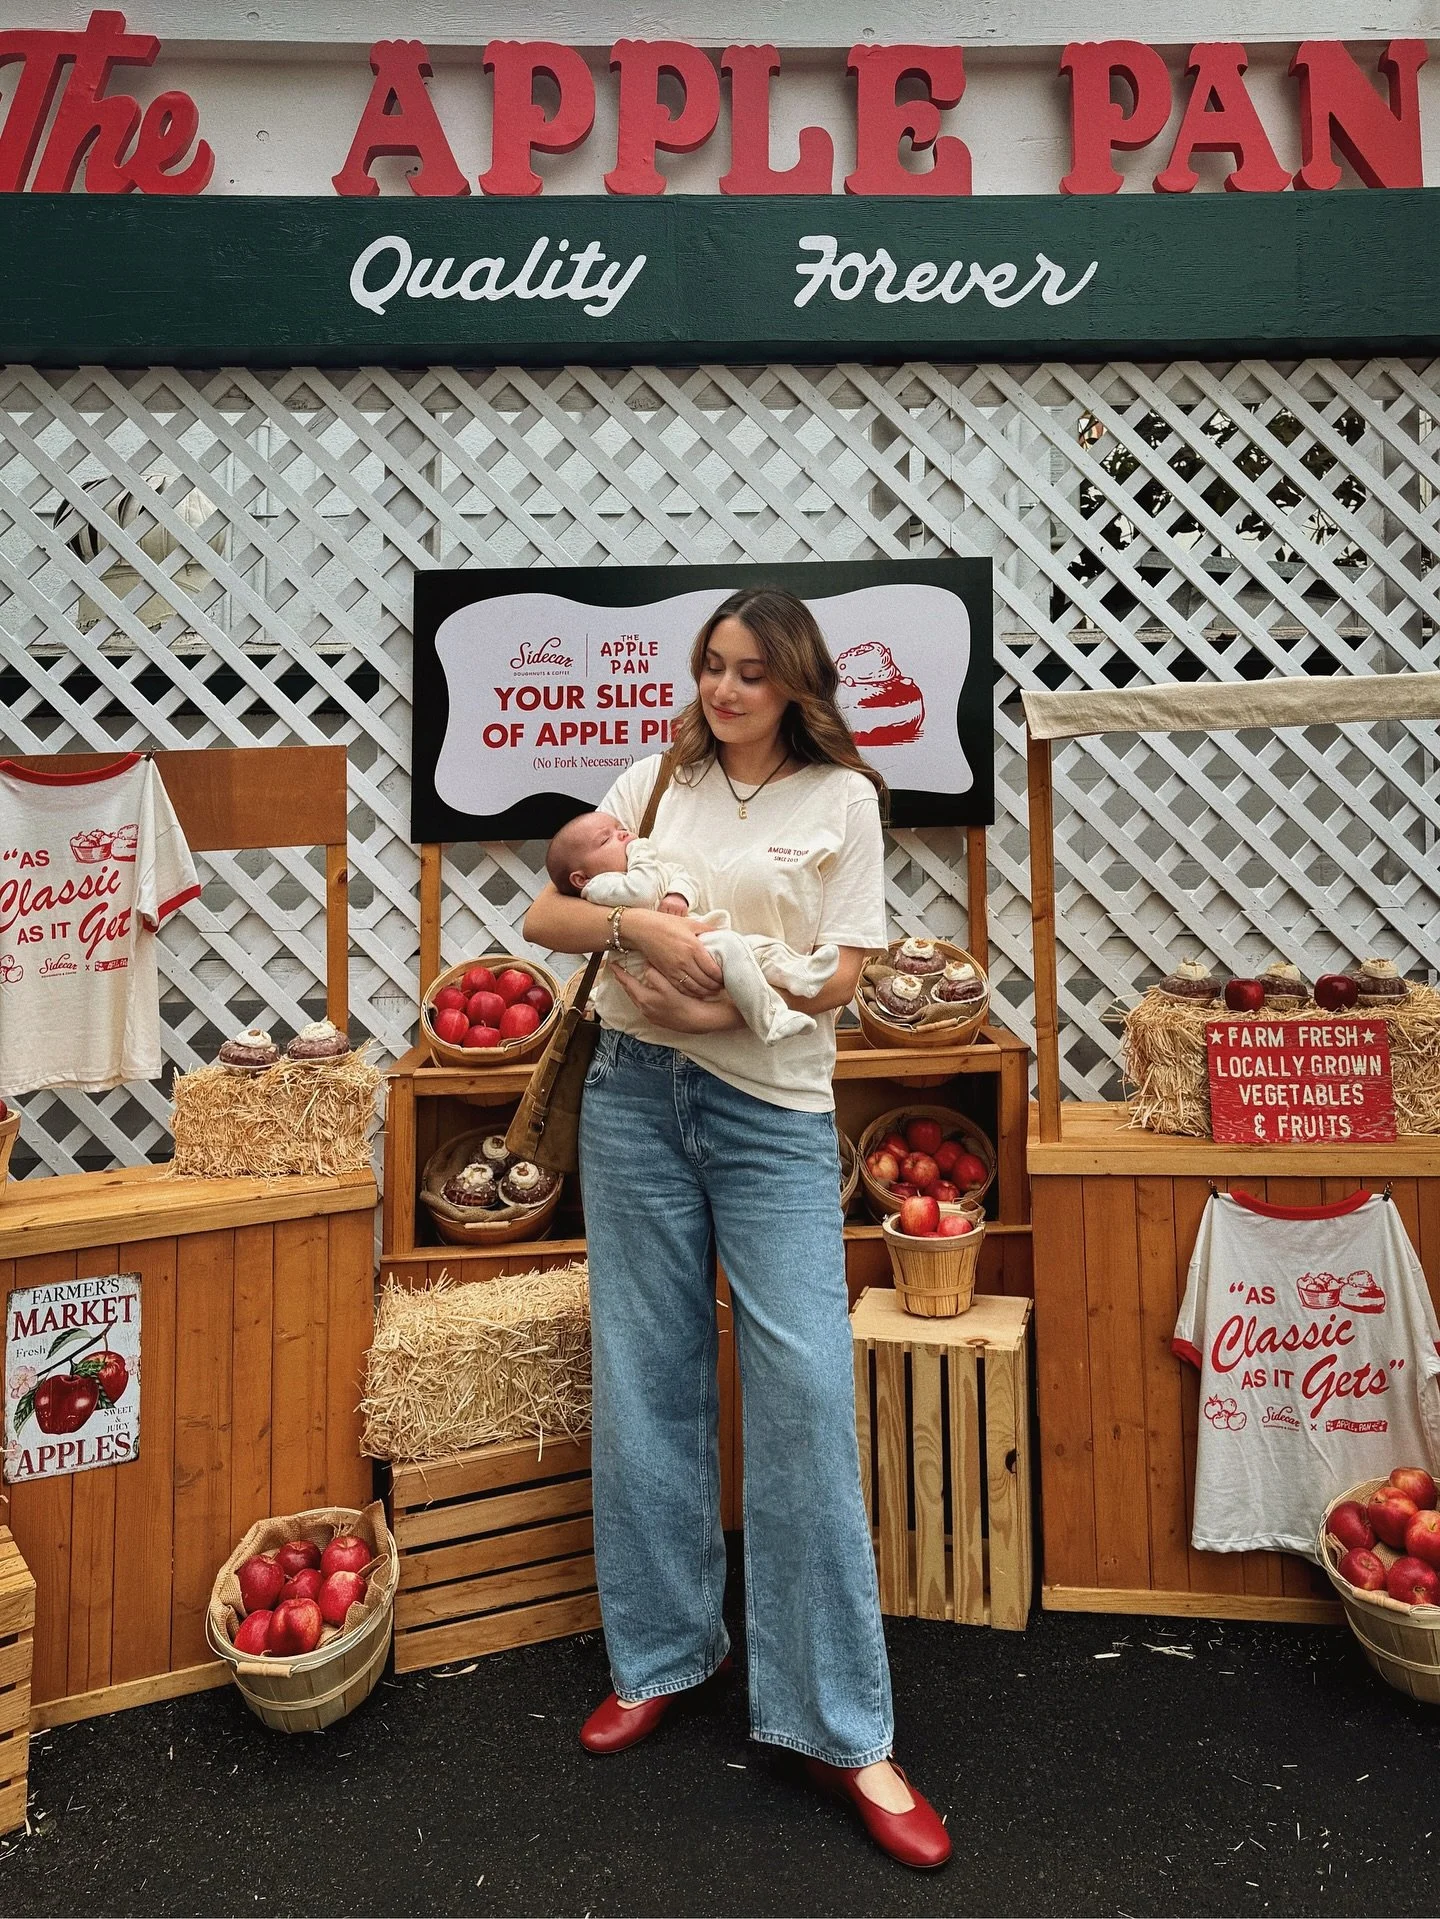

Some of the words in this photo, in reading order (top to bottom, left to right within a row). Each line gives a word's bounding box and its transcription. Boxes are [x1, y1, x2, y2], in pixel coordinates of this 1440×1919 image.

[0, 10, 215, 194] The
[332, 39, 973, 196] APPLE
[1058, 39, 1428, 196] PAN
[349, 235, 647, 318] Quality
[793, 235, 1099, 308] Forever
[600, 641, 659, 657] APPLE
[620, 634, 640, 642] THE
[510, 637, 574, 669] Sidecar
[610, 659, 650, 675] PAN
[494, 685, 585, 711] YOUR
[597, 683, 674, 709] SLICE
[483, 723, 525, 749] OF
[535, 720, 629, 746] APPLE
[533, 757, 550, 770] (No
[554, 757, 578, 769] Fork
[580, 756, 635, 770] Necessary)
[768, 846, 791, 855] AMOUR
[0, 866, 121, 934] Classic
[17, 925, 44, 945] AS
[51, 922, 71, 940] IT
[39, 953, 78, 974] Sidecar
[1228, 1027, 1284, 1048] FARM
[1299, 1025, 1358, 1047] FRESH
[1217, 1056, 1305, 1077] LOCALLY
[1310, 1054, 1382, 1077] GROWN
[1239, 1083, 1364, 1106] VEGETABLES
[1278, 1115, 1351, 1137] FRUITS
[32, 1278, 120, 1305] FARMER’S
[11, 1294, 137, 1342] MARKET
[16, 1345, 46, 1358] Fresh
[1211, 1314, 1356, 1374] Classic
[1241, 1369, 1267, 1390] AS
[1274, 1369, 1294, 1389] IT
[103, 1405, 133, 1417] SWEET
[1261, 1406, 1300, 1427] Sidecar
[106, 1422, 130, 1433] JUICY
[15, 1432, 131, 1478] APPLES
